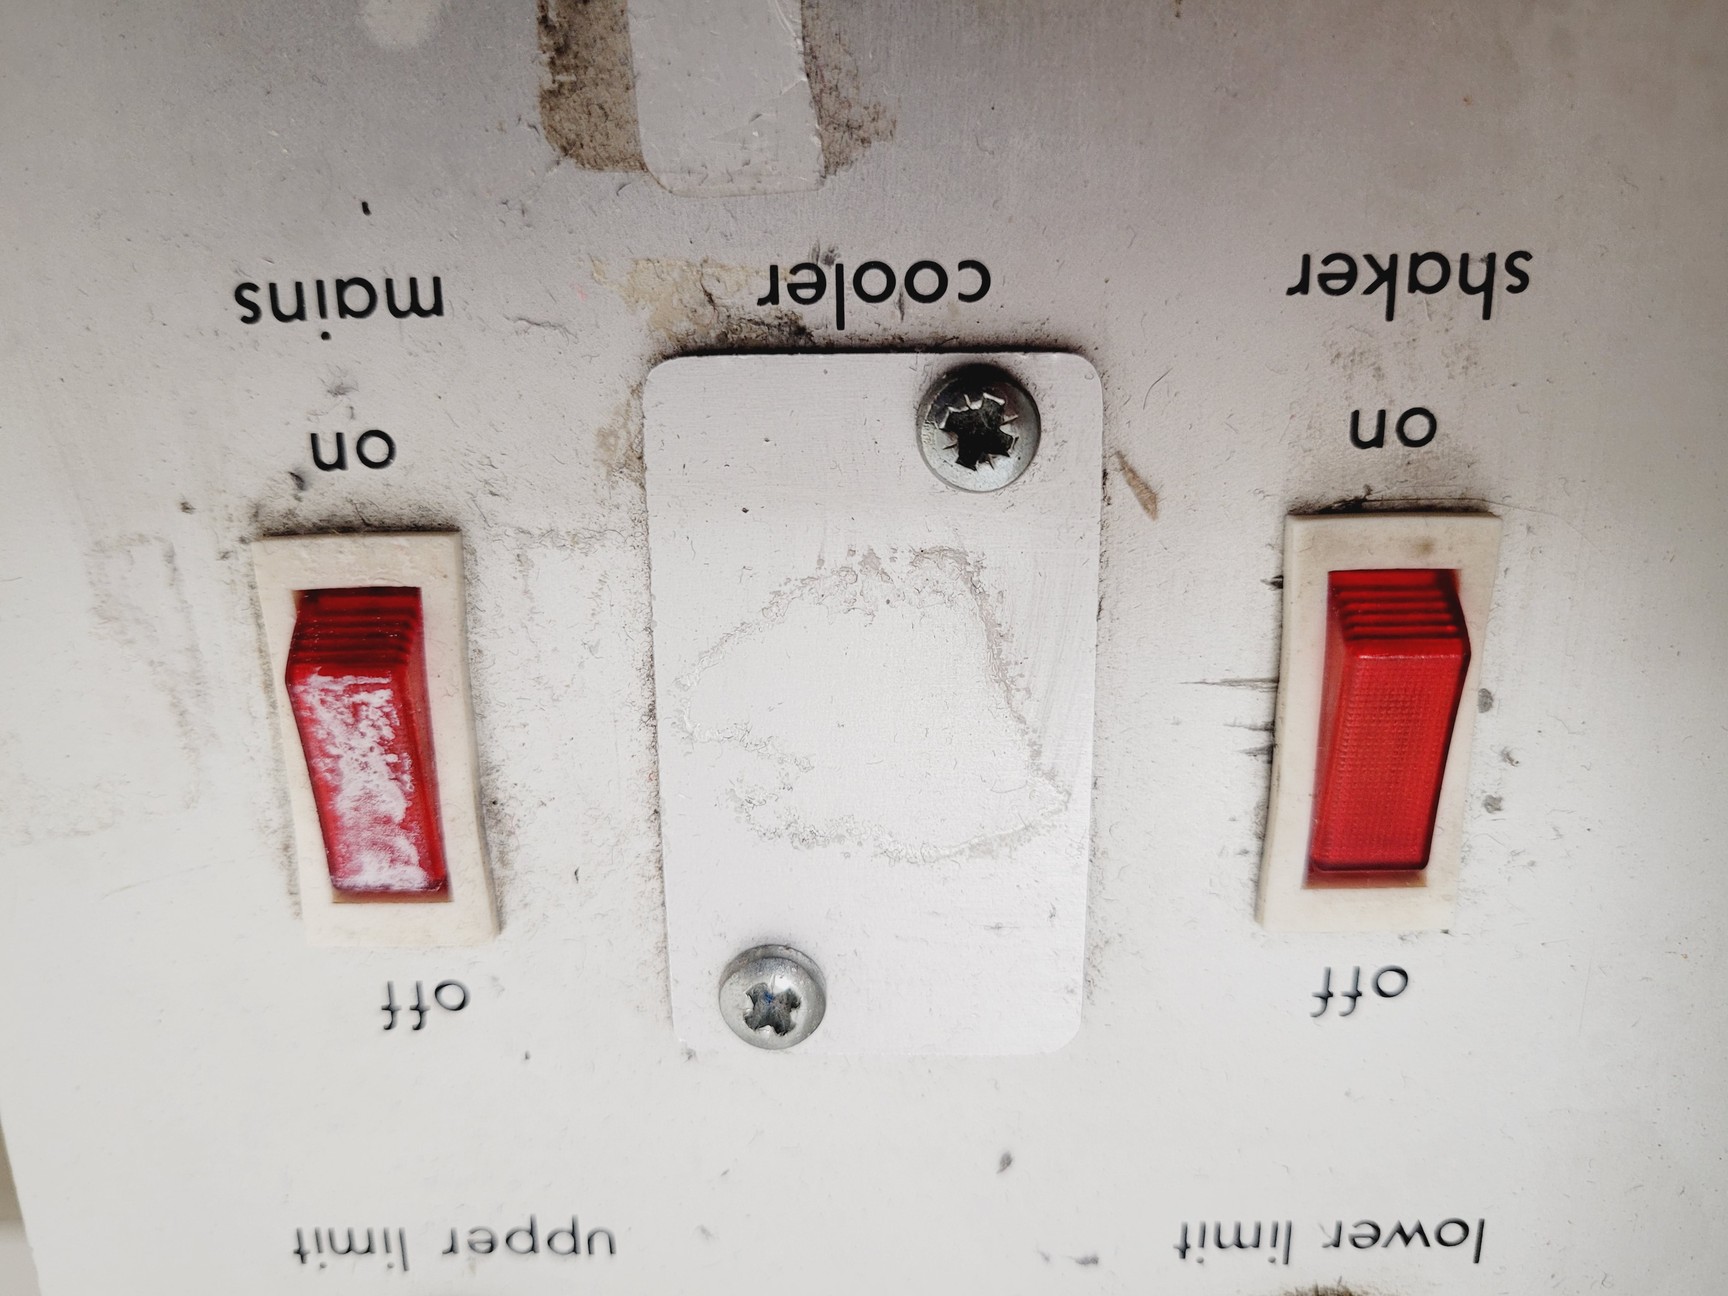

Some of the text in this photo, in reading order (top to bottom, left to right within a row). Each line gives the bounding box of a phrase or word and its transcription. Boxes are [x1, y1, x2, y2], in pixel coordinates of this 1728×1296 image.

[233, 275, 444, 341] mains
[757, 258, 992, 331] cooler
[1286, 248, 1534, 322] shaker
[309, 428, 396, 473] on
[1349, 405, 1438, 450] on
[380, 979, 470, 1032] off
[1310, 964, 1410, 1018] off
[292, 1214, 617, 1272] upper limit
[1174, 1217, 1486, 1266] lower limit
